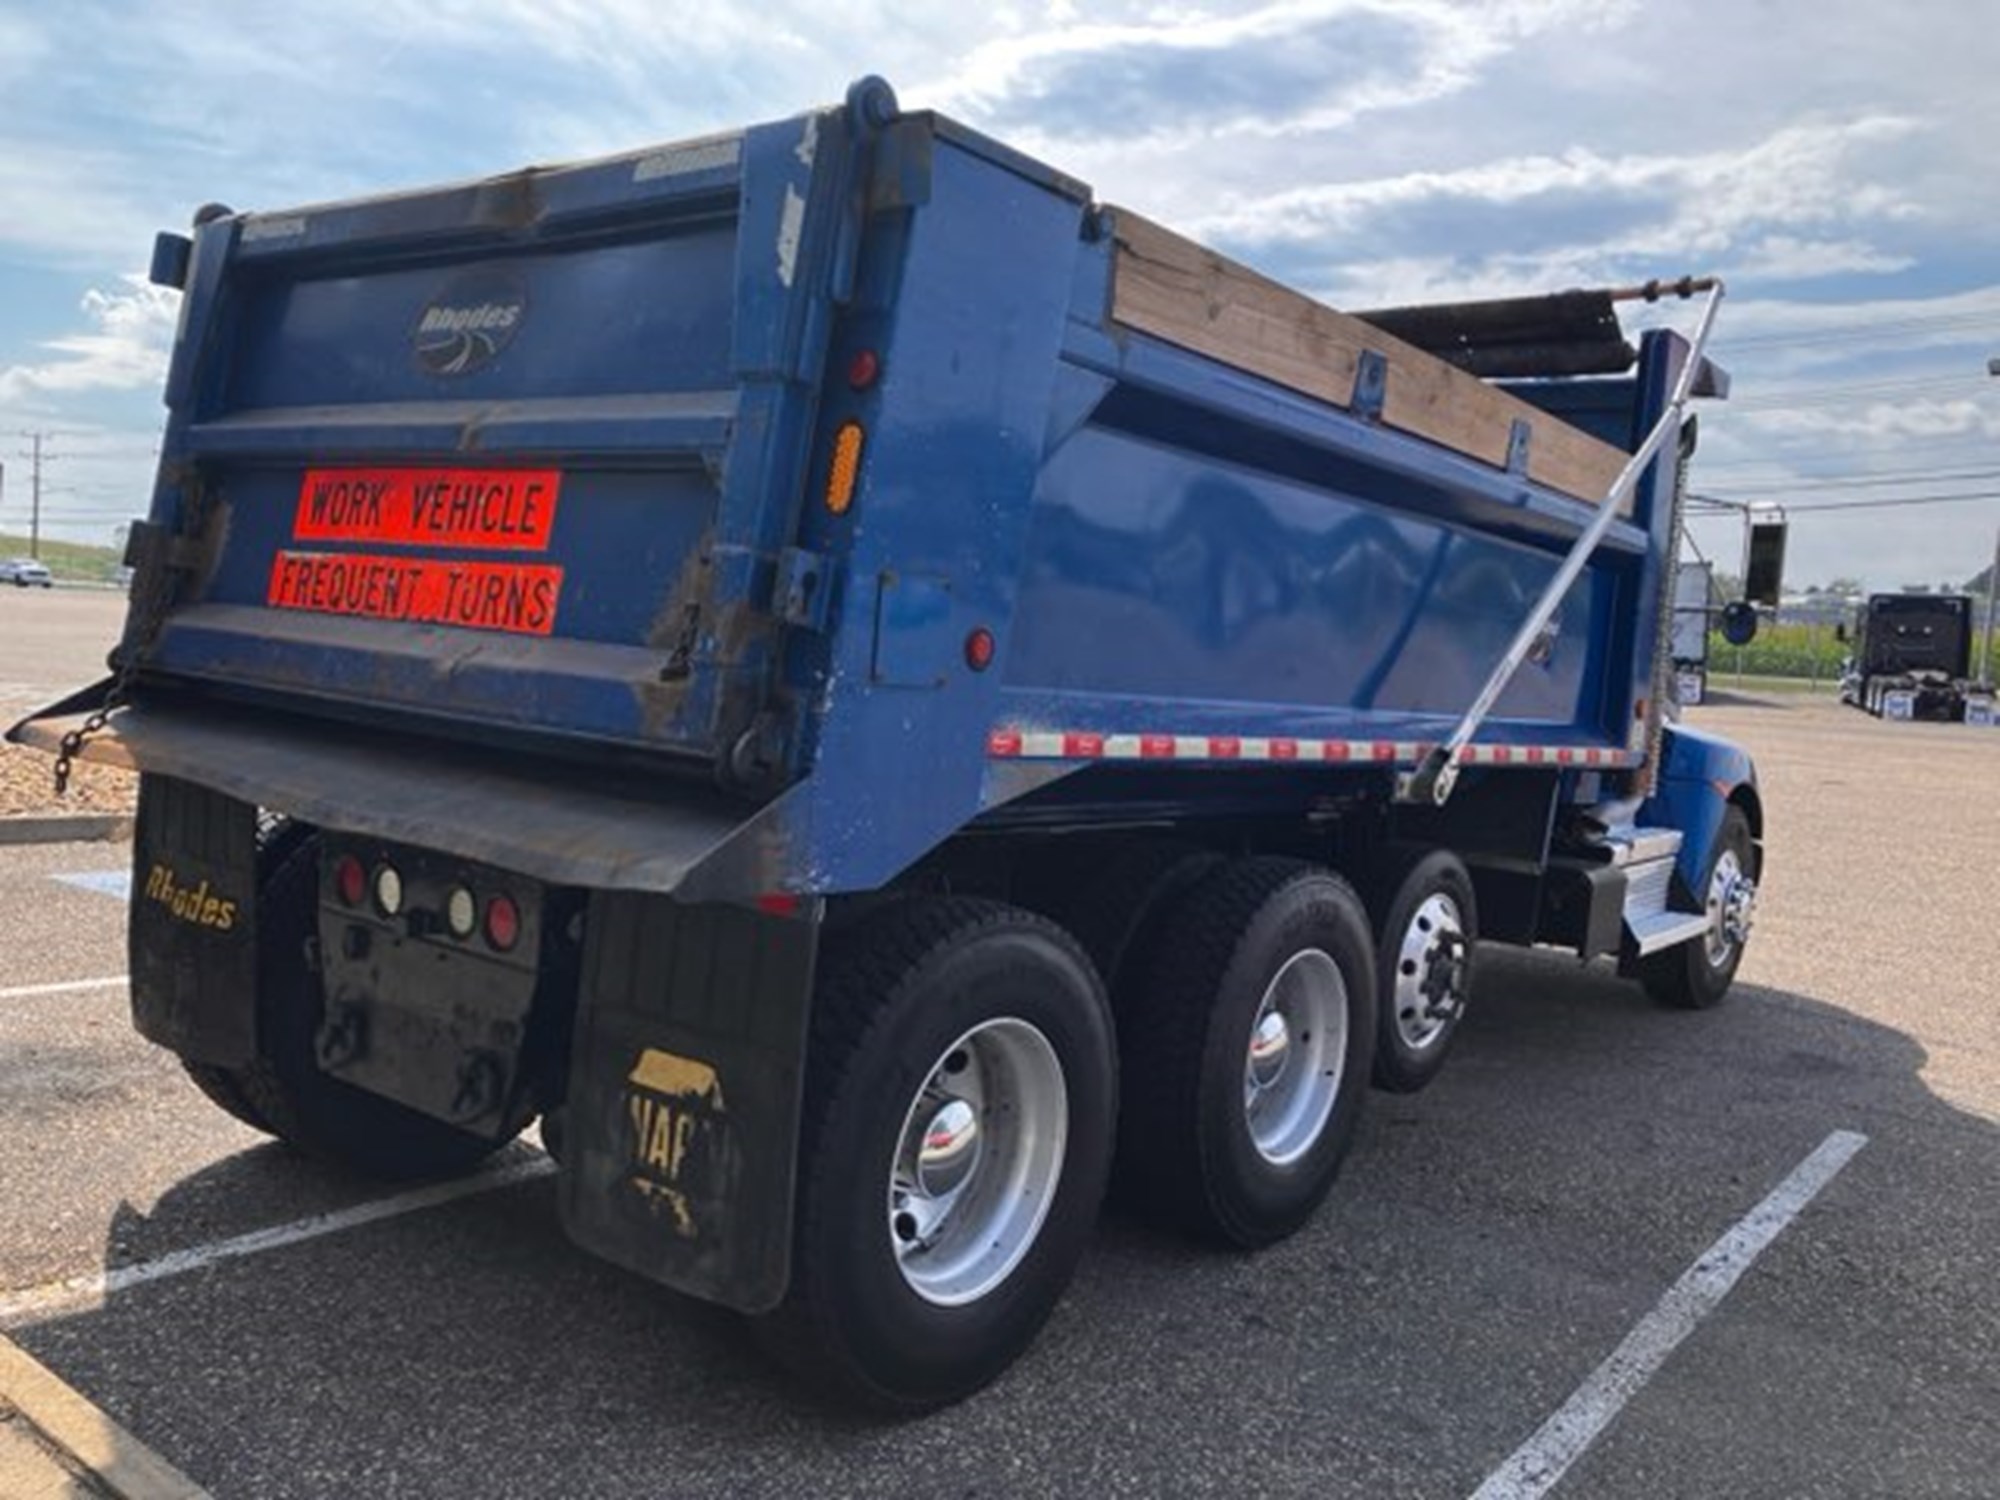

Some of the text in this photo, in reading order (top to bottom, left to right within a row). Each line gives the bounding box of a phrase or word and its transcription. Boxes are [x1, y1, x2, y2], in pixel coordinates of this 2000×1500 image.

[420, 304, 520, 331] Rhodes
[309, 480, 542, 533] WORK VEHICLE
[278, 559, 551, 628] FREQUENT TURNS
[146, 865, 235, 929] Rhodes
